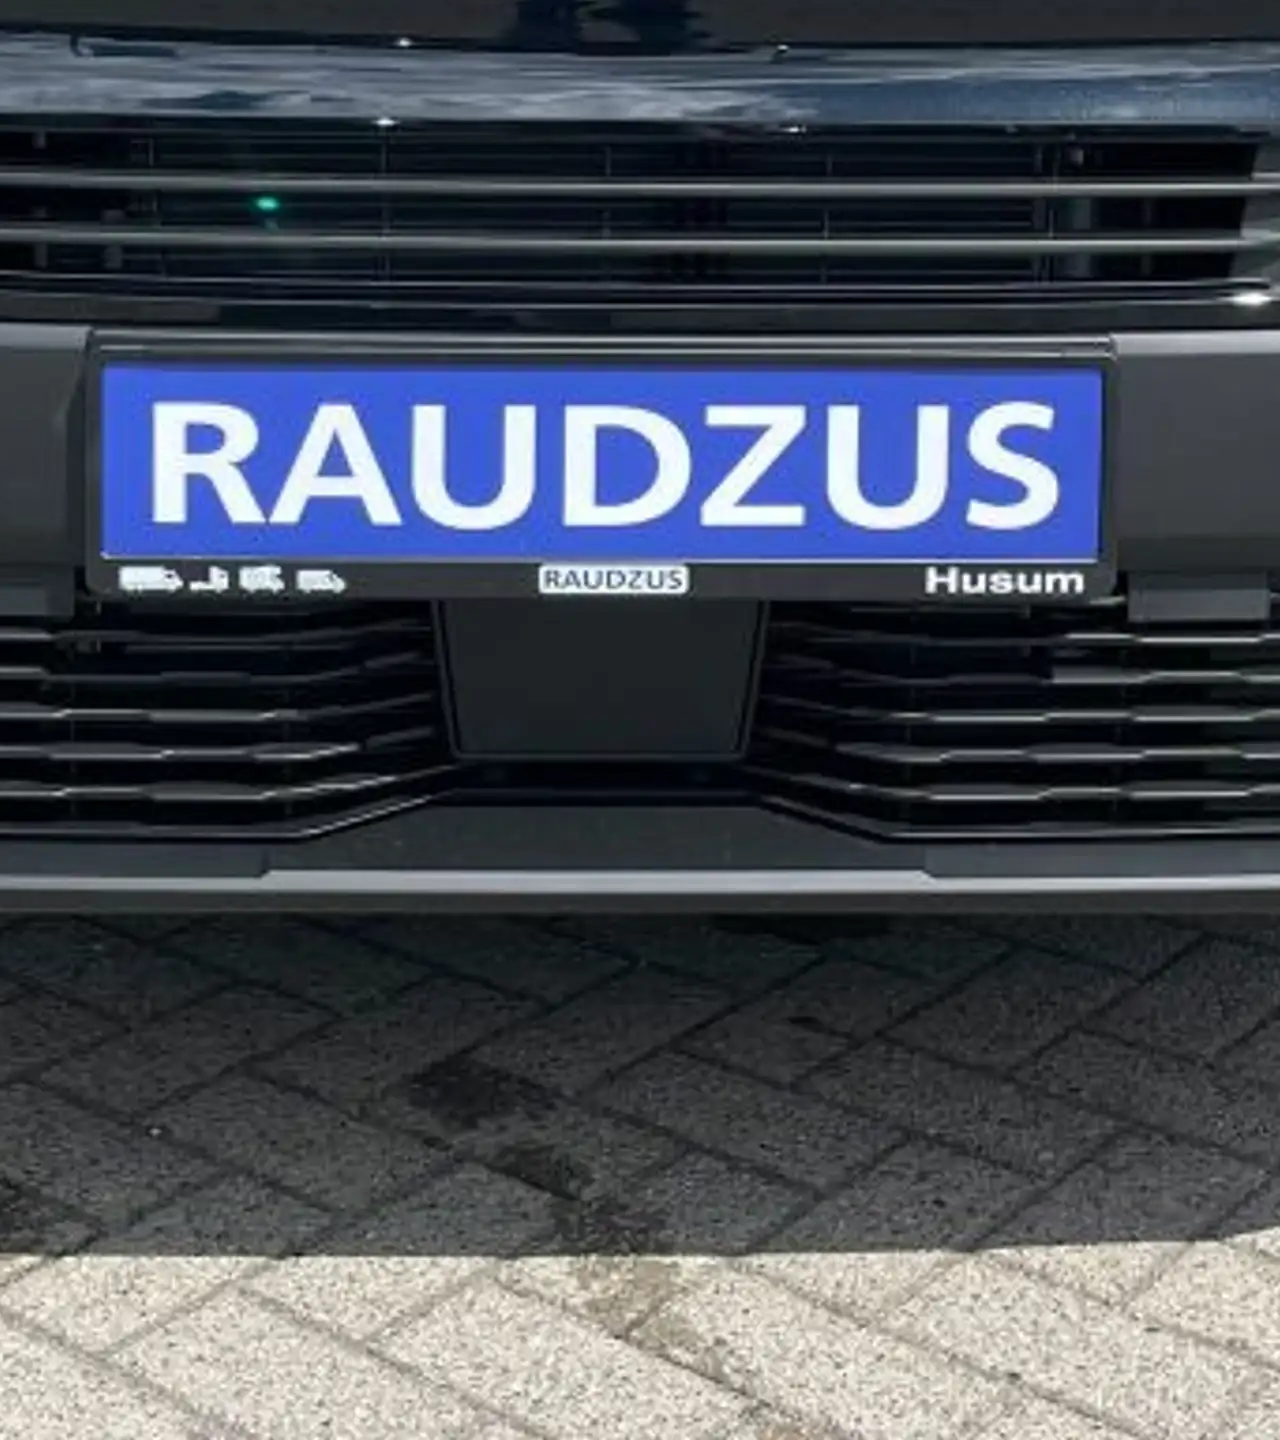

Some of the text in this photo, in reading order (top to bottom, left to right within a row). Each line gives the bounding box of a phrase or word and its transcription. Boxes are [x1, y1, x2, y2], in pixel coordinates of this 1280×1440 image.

[151, 400, 1061, 531] RAUDZUS
[543, 570, 686, 590] RAUDZUS
[924, 565, 1086, 595] Husum
